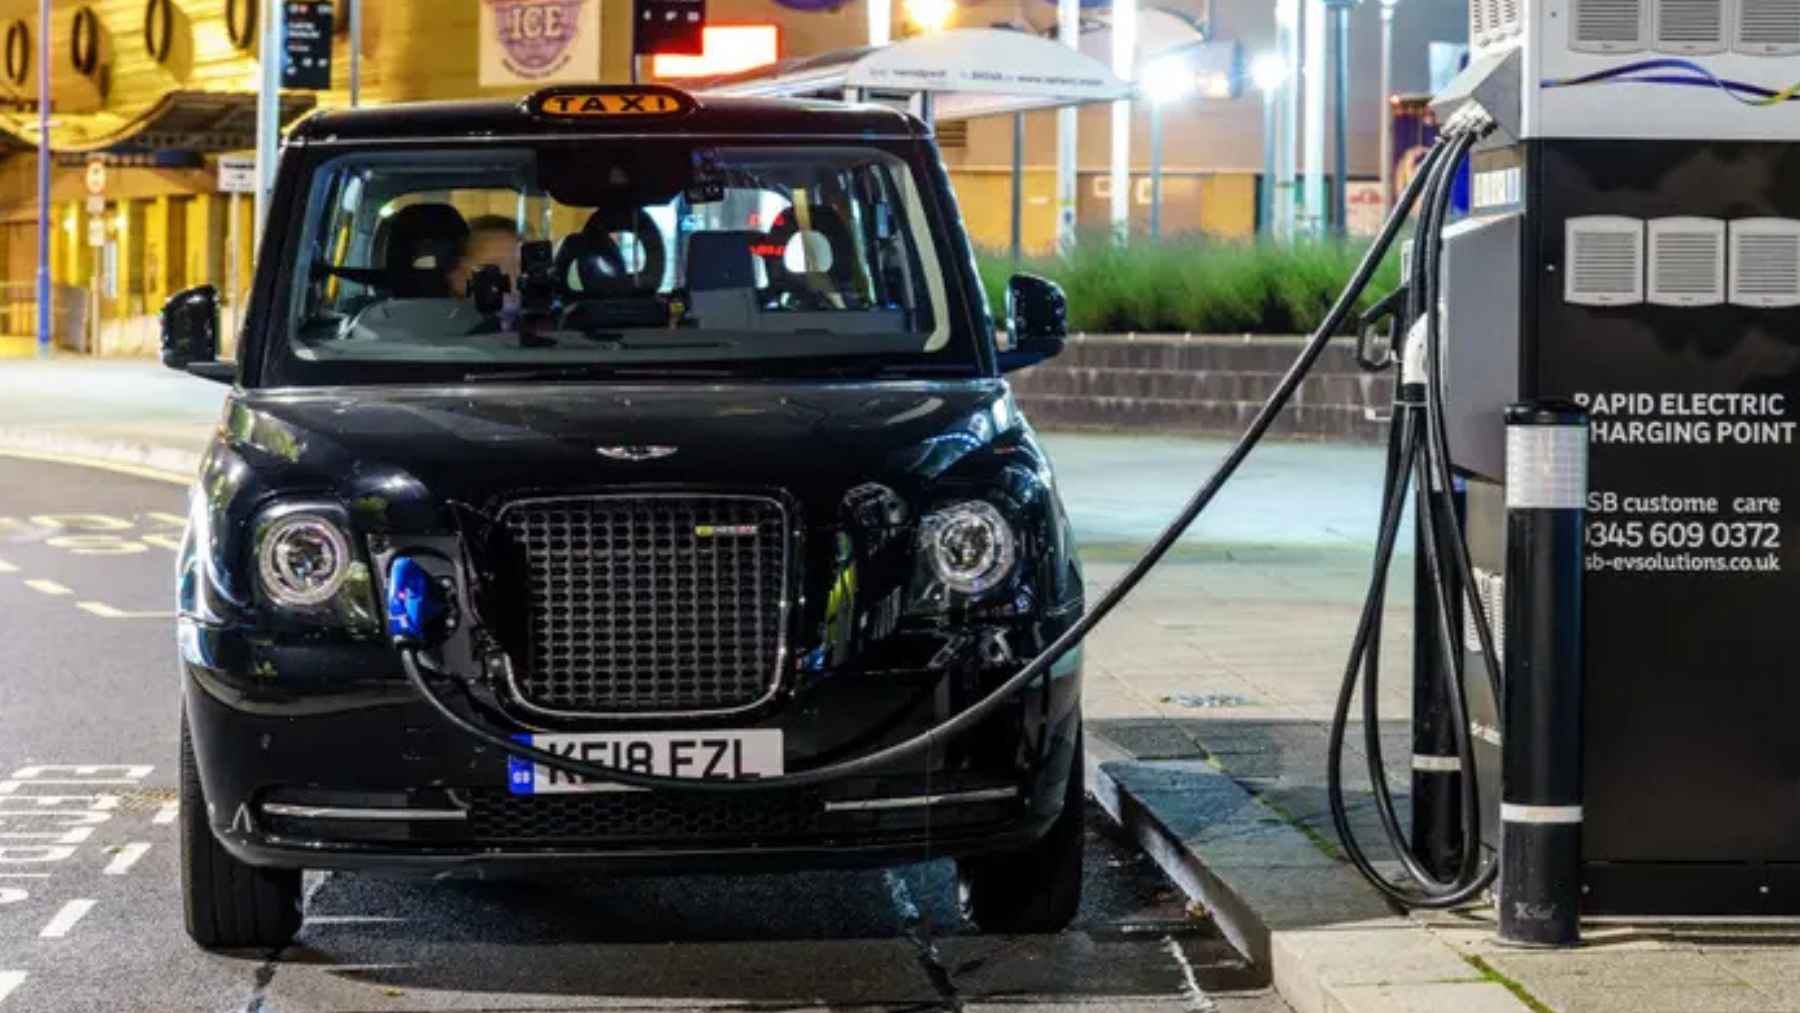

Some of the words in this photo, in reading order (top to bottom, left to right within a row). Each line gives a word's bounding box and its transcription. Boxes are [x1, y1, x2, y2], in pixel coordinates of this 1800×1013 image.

[510, 6, 563, 40] ICE
[553, 95, 668, 113] TAXI
[1660, 393, 1785, 416] ELECTRIC
[1588, 421, 1711, 444] HARGING
[1716, 421, 1797, 444] POINT
[1586, 491, 1618, 513] SB
[1732, 496, 1781, 514] care
[1649, 521, 1705, 548] 609
[1710, 521, 1781, 548] 0372
[1584, 552, 1781, 572] sb-evsolutions.co.uk
